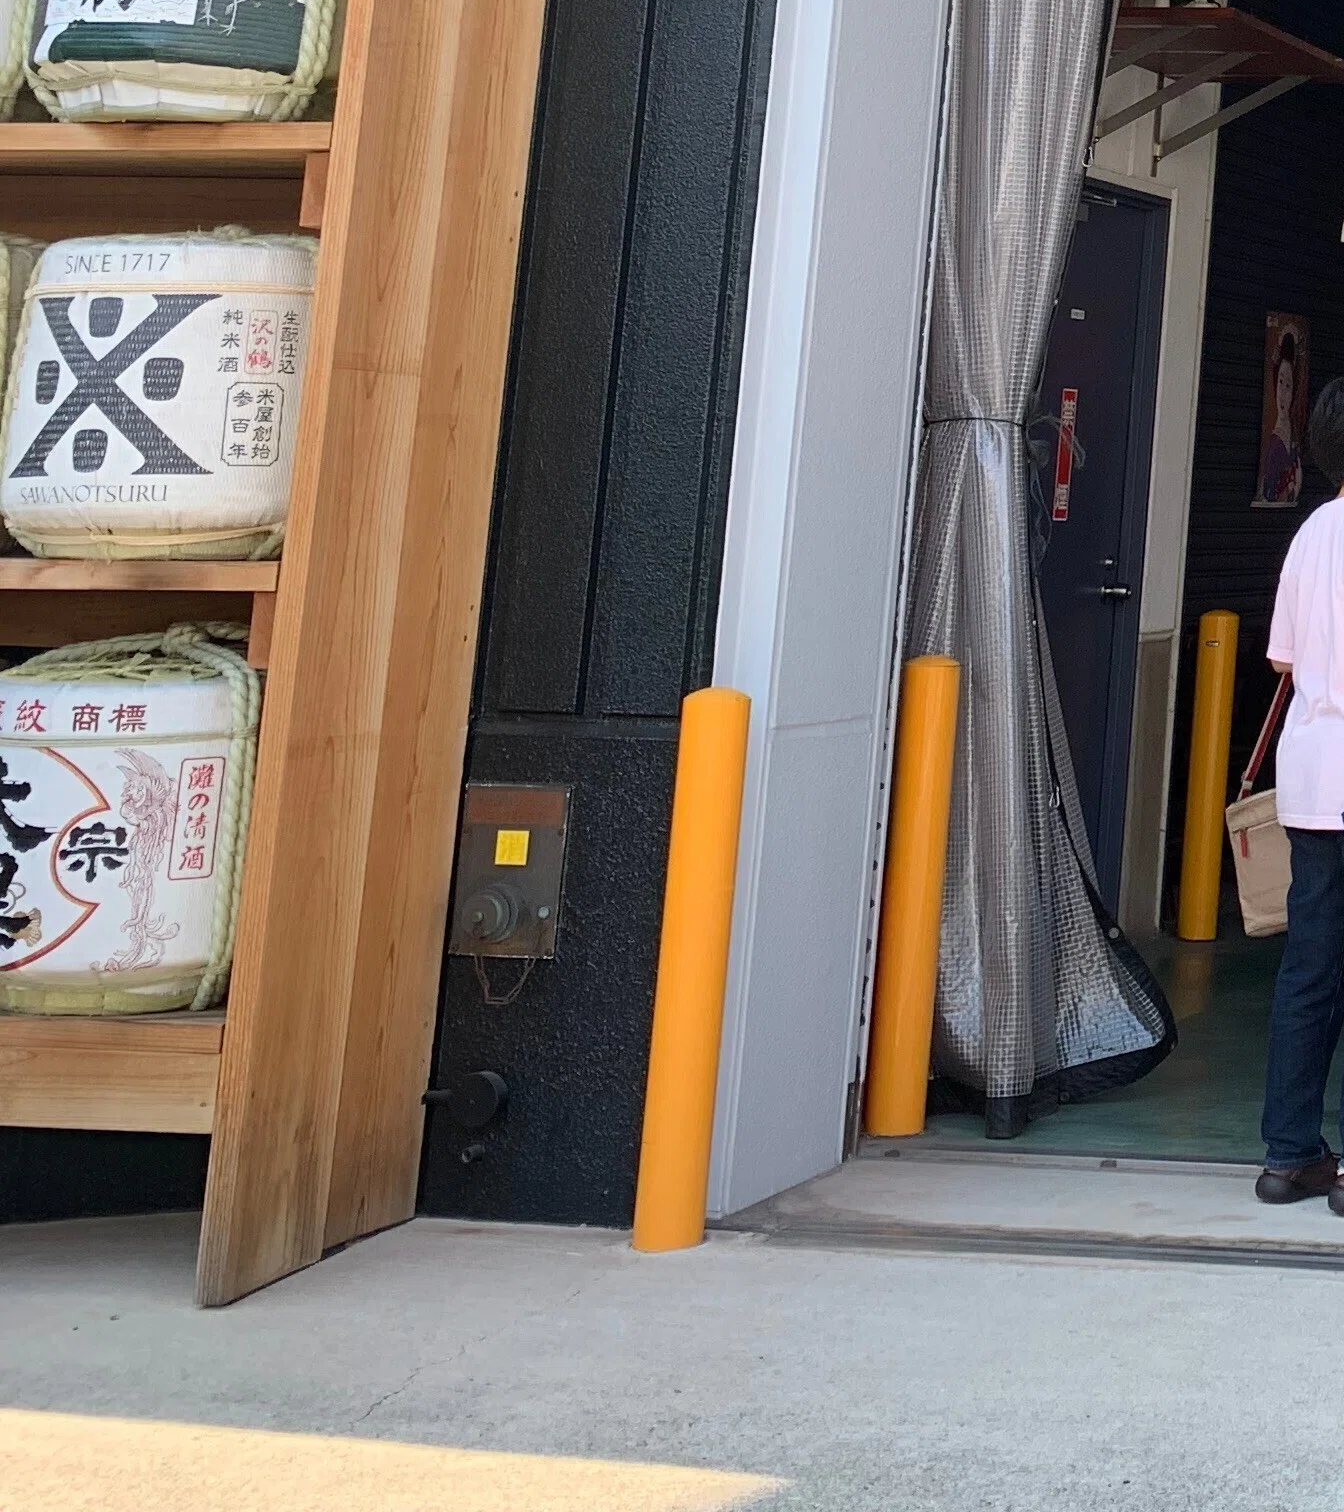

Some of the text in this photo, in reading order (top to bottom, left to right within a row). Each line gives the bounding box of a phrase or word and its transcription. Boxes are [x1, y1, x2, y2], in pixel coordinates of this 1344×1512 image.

[65, 253, 171, 274] SINCE 1717
[217, 309, 243, 373] 純米酒
[247, 318, 274, 369] 沢の鶴
[228, 390, 253, 460] 参百年
[251, 388, 275, 459] 米屋創始
[20, 484, 169, 505] SAWANOTSURU
[0, 699, 148, 733] 紋商標
[179, 764, 215, 870] 灘の清酒
[59, 822, 129, 883] 宗
